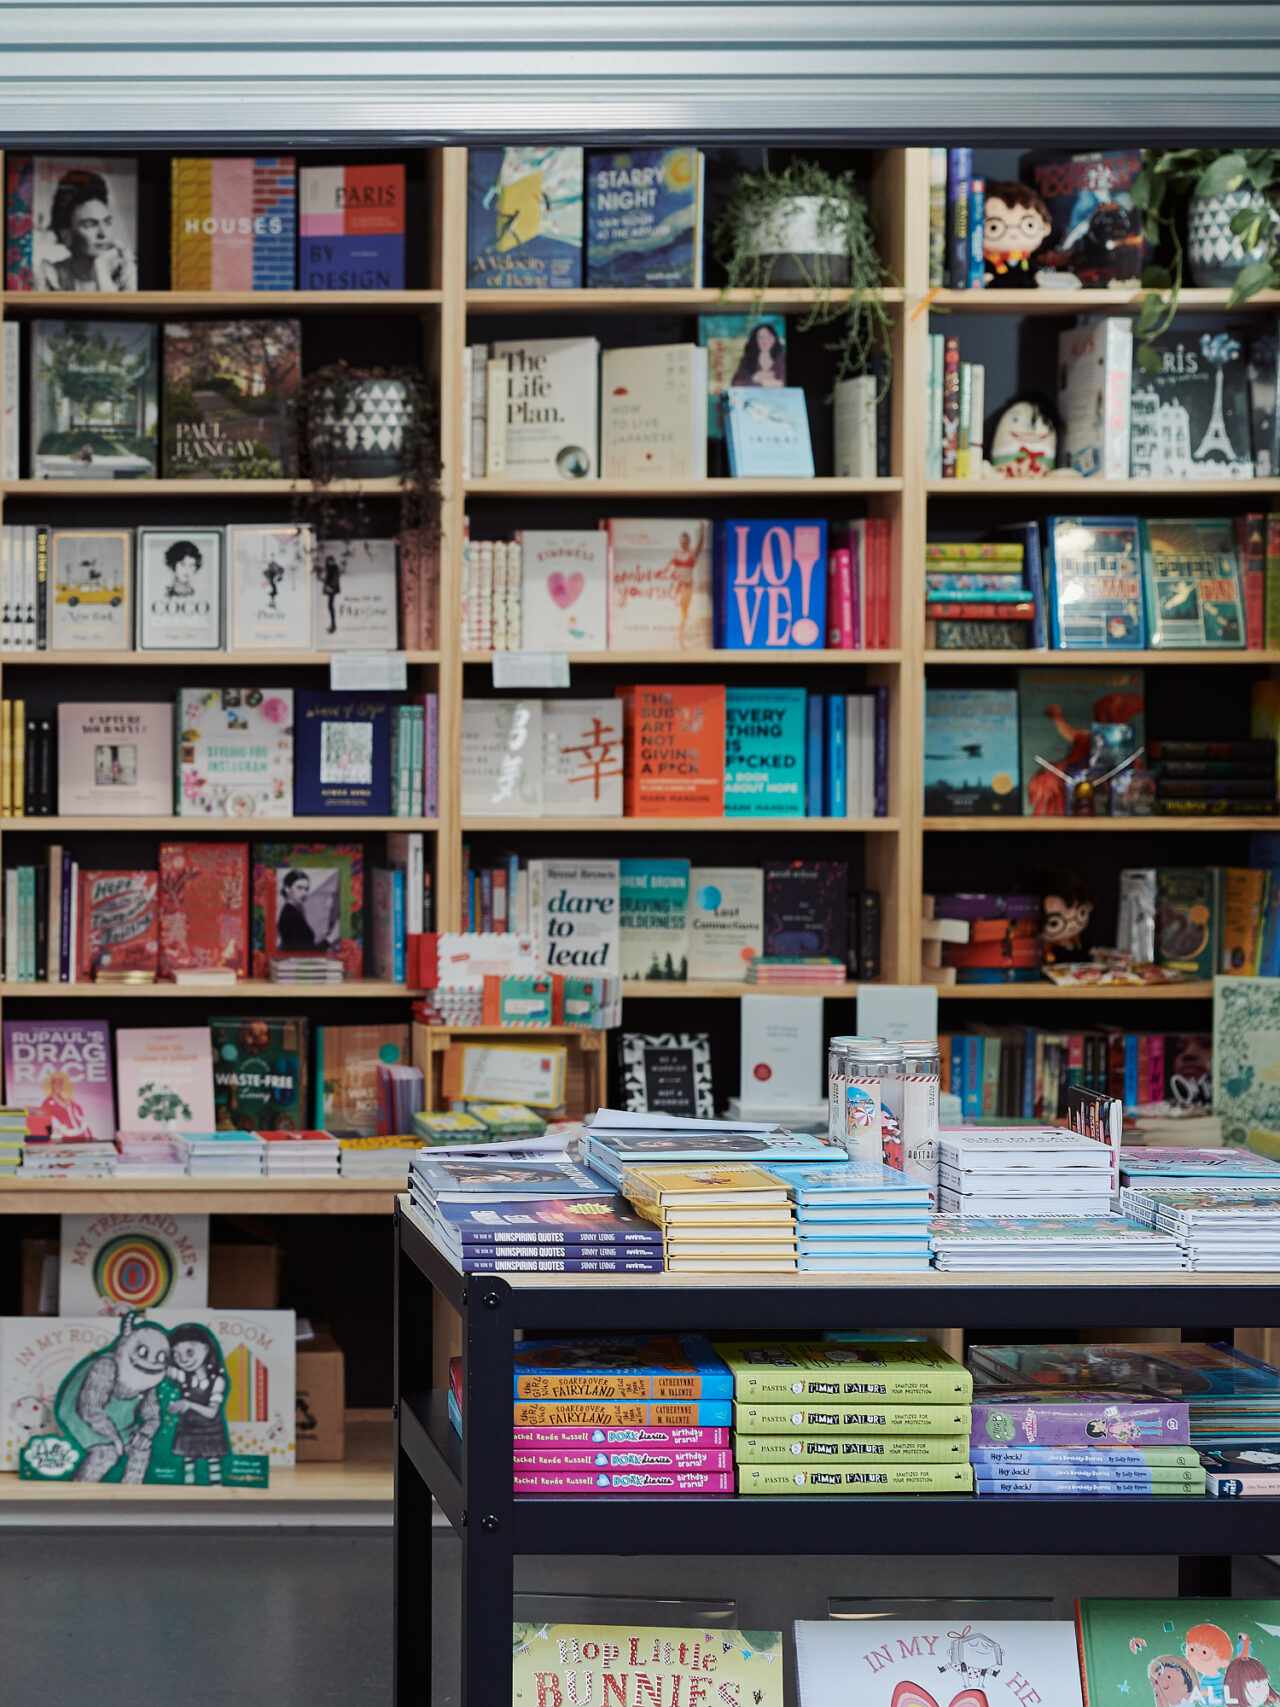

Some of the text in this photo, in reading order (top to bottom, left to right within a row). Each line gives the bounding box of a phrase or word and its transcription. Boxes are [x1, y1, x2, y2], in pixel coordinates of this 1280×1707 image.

[597, 166, 666, 189] STARRY
[335, 185, 396, 209] PARIS
[597, 189, 657, 211] NIGHT
[184, 216, 283, 235] HOUSES
[311, 245, 334, 263] BY
[309, 270, 391, 289] DESIGN
[501, 349, 547, 373] The
[506, 375, 552, 399] Life
[506, 401, 565, 425] Plan.
[176, 422, 227, 440] PAUL
[175, 438, 257, 459] BANGAY
[151, 602, 210, 615] COCO
[726, 708, 786, 721] EVERY
[726, 725, 782, 737] THING
[641, 736, 675, 747] NOT
[726, 740, 742, 752] IS
[547, 889, 614, 914] dare
[547, 917, 575, 938] to
[547, 943, 609, 967] lead
[12, 1030, 105, 1044] RUPAUL'S
[12, 1044, 107, 1063] DRAG
[13, 1063, 107, 1083] RACE
[216, 1072, 294, 1089] WASTE-FREE
[495, 1232, 564, 1242] UNINSPIRING QUOTES
[495, 1246, 565, 1257] UNINSPIRING QUOTES
[495, 1260, 565, 1271] UNINSPIRING QUOTES
[553, 1385, 616, 1399] FAIRYLAND
[808, 1383, 840, 1394] TIMMY
[843, 1383, 887, 1394] FAILURE
[549, 1412, 612, 1426] FAIRYLAND
[808, 1414, 840, 1425] TIMMY
[843, 1414, 887, 1425] FAILURE
[807, 1444, 885, 1455] TIMMY FAILURE
[810, 1474, 888, 1485] TIMMY FAILURE
[861, 1634, 940, 1674] IN MY
[534, 1670, 742, 1707] BUNNIES
